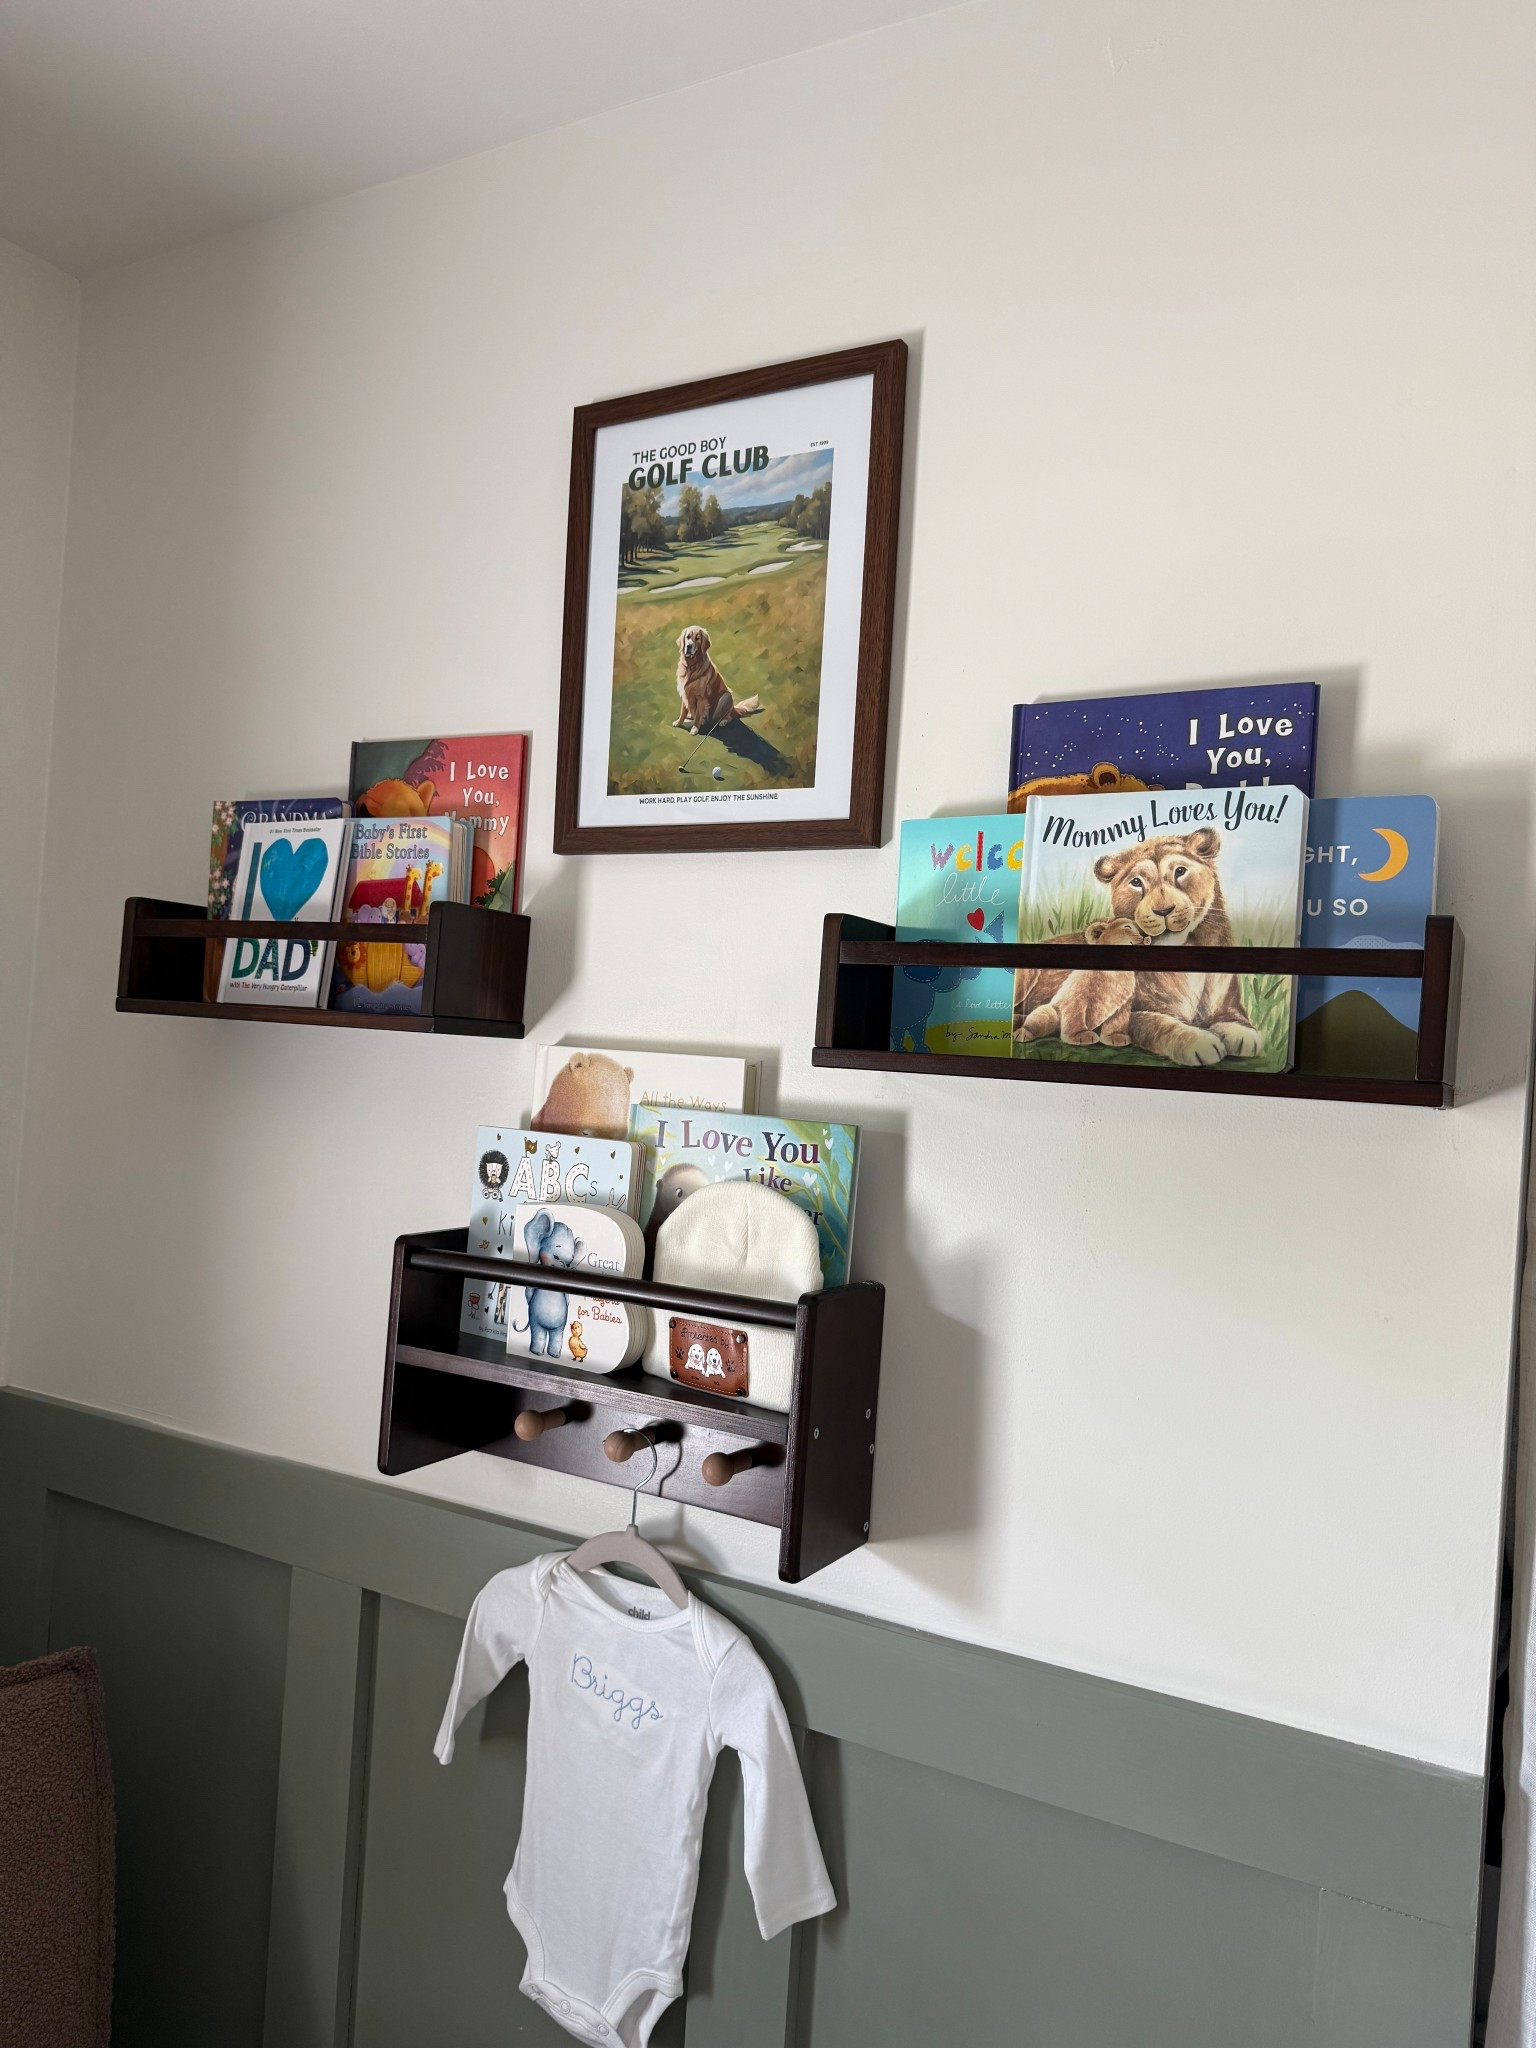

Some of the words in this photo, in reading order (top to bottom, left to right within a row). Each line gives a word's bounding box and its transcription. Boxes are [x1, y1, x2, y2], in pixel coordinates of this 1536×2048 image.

[633, 451, 656, 465] THE
[659, 442, 697, 460] GOOD
[700, 436, 727, 453] BOY
[628, 458, 693, 491] GOLF
[701, 445, 770, 479] CLUB
[1189, 719, 1199, 746] I
[1218, 713, 1293, 740] Love
[450, 761, 456, 782] I
[466, 760, 509, 781] Love
[1206, 747, 1271, 775] You,
[462, 786, 500, 807] You,
[639, 797, 657, 805] WORK
[710, 794, 732, 802] ENJOY
[733, 793, 745, 801] THE
[746, 792, 778, 801] SUNSHINE
[1042, 815, 1147, 849] Mommy
[1151, 799, 1218, 828] Loves
[1223, 790, 1289, 831] You!
[355, 822, 395, 843] Baby's
[399, 823, 428, 840] First
[350, 843, 383, 860] Bible
[386, 843, 430, 860] Stories
[930, 830, 1024, 872] welco
[241, 842, 262, 921] I
[936, 872, 1006, 906] little
[1332, 898, 1369, 916] SO
[231, 937, 312, 981] DAD
[241, 981, 251, 989] The
[251, 982, 262, 990] Very
[262, 983, 280, 992] Hungry
[280, 983, 308, 993] Caterpillar
[965, 1026, 1000, 1041] Sandra
[640, 1091, 659, 1107] All
[662, 1091, 685, 1109] the
[690, 1095, 727, 1113] Ways
[655, 1119, 668, 1149] I
[681, 1119, 753, 1158] Love
[762, 1131, 820, 1165] You
[508, 1156, 598, 1203] ABCs
[587, 1252, 620, 1272] Great
[577, 1305, 590, 1320] for
[591, 1305, 622, 1324] Babies
[627, 1606, 651, 1621] child
[571, 1653, 663, 1730] Briggs
